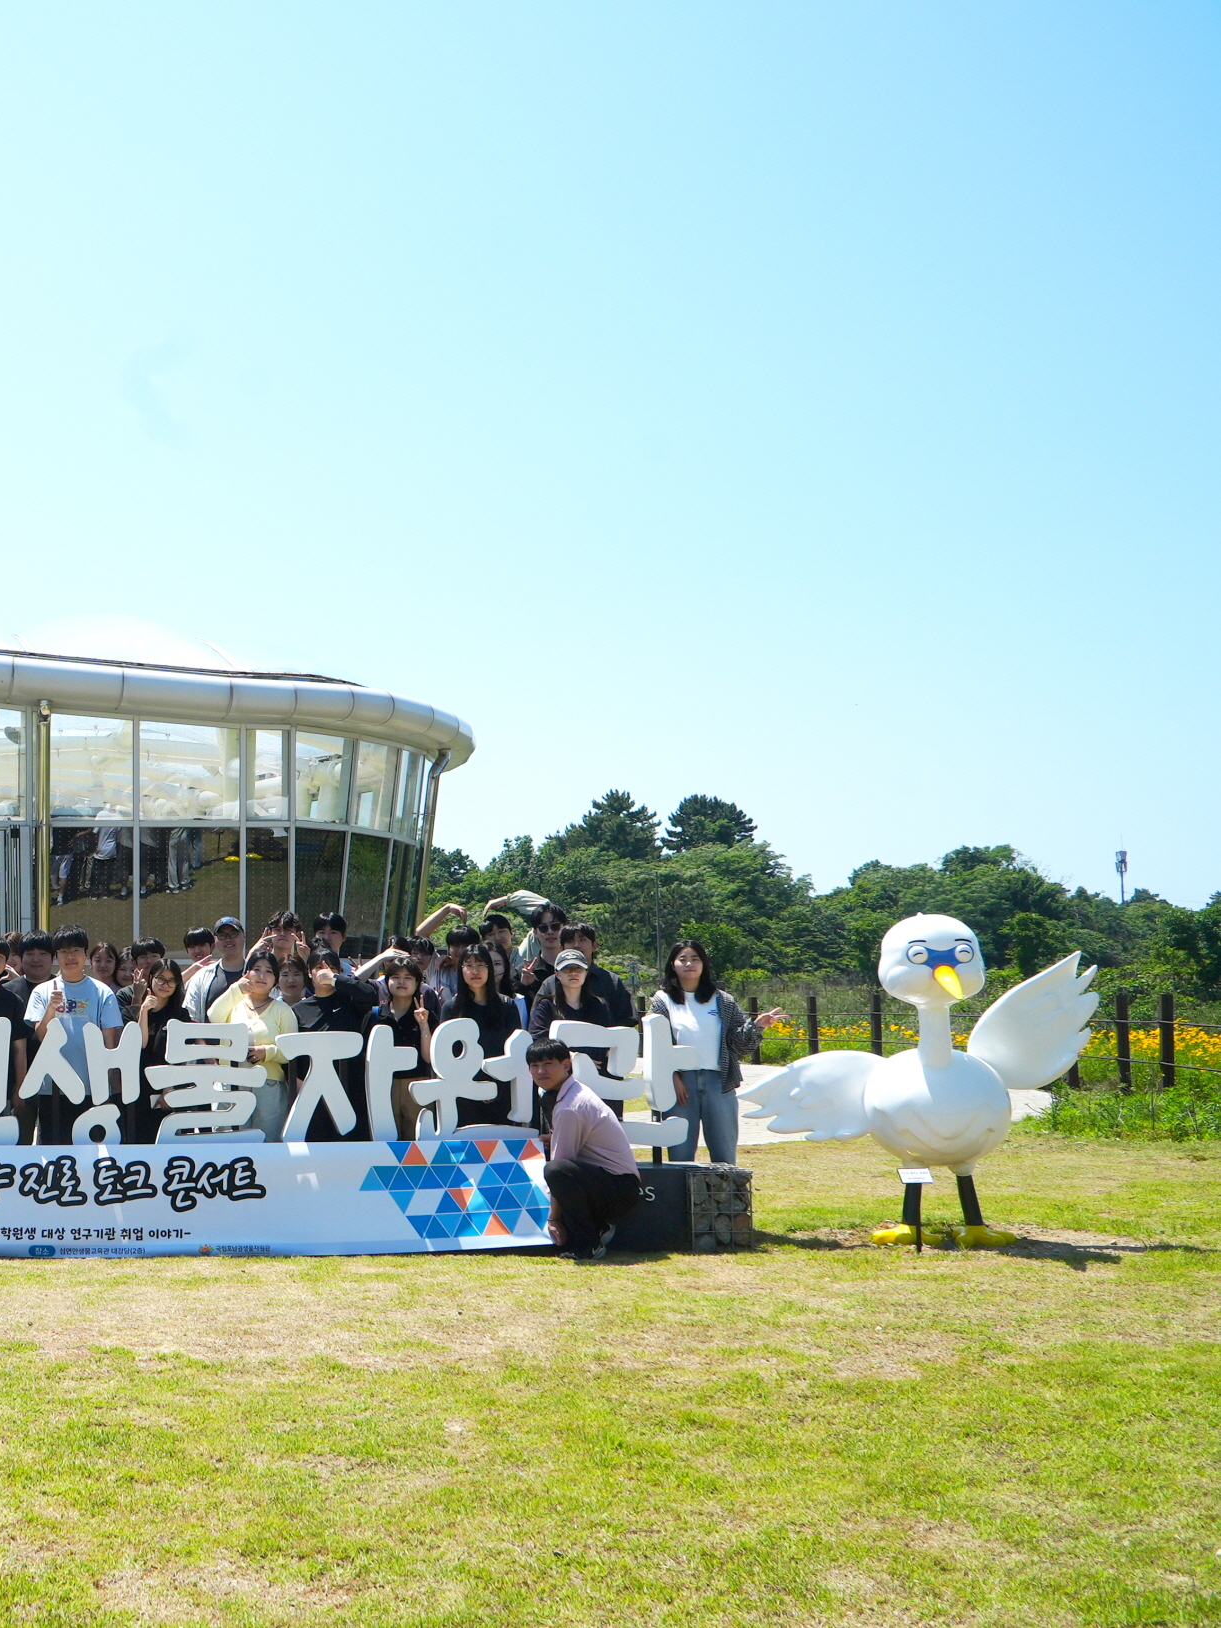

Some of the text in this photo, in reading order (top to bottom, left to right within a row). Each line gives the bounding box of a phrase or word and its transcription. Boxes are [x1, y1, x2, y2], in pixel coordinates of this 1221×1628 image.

[19, 1155, 87, 1207] 진로
[93, 1156, 158, 1206] 토크
[162, 1156, 266, 1212] 콘서트
[41, 1227, 66, 1241] 대상
[70, 1227, 116, 1241] 연구기관
[120, 1227, 144, 1241] 취업
[34, 1247, 50, 1256] 장소
